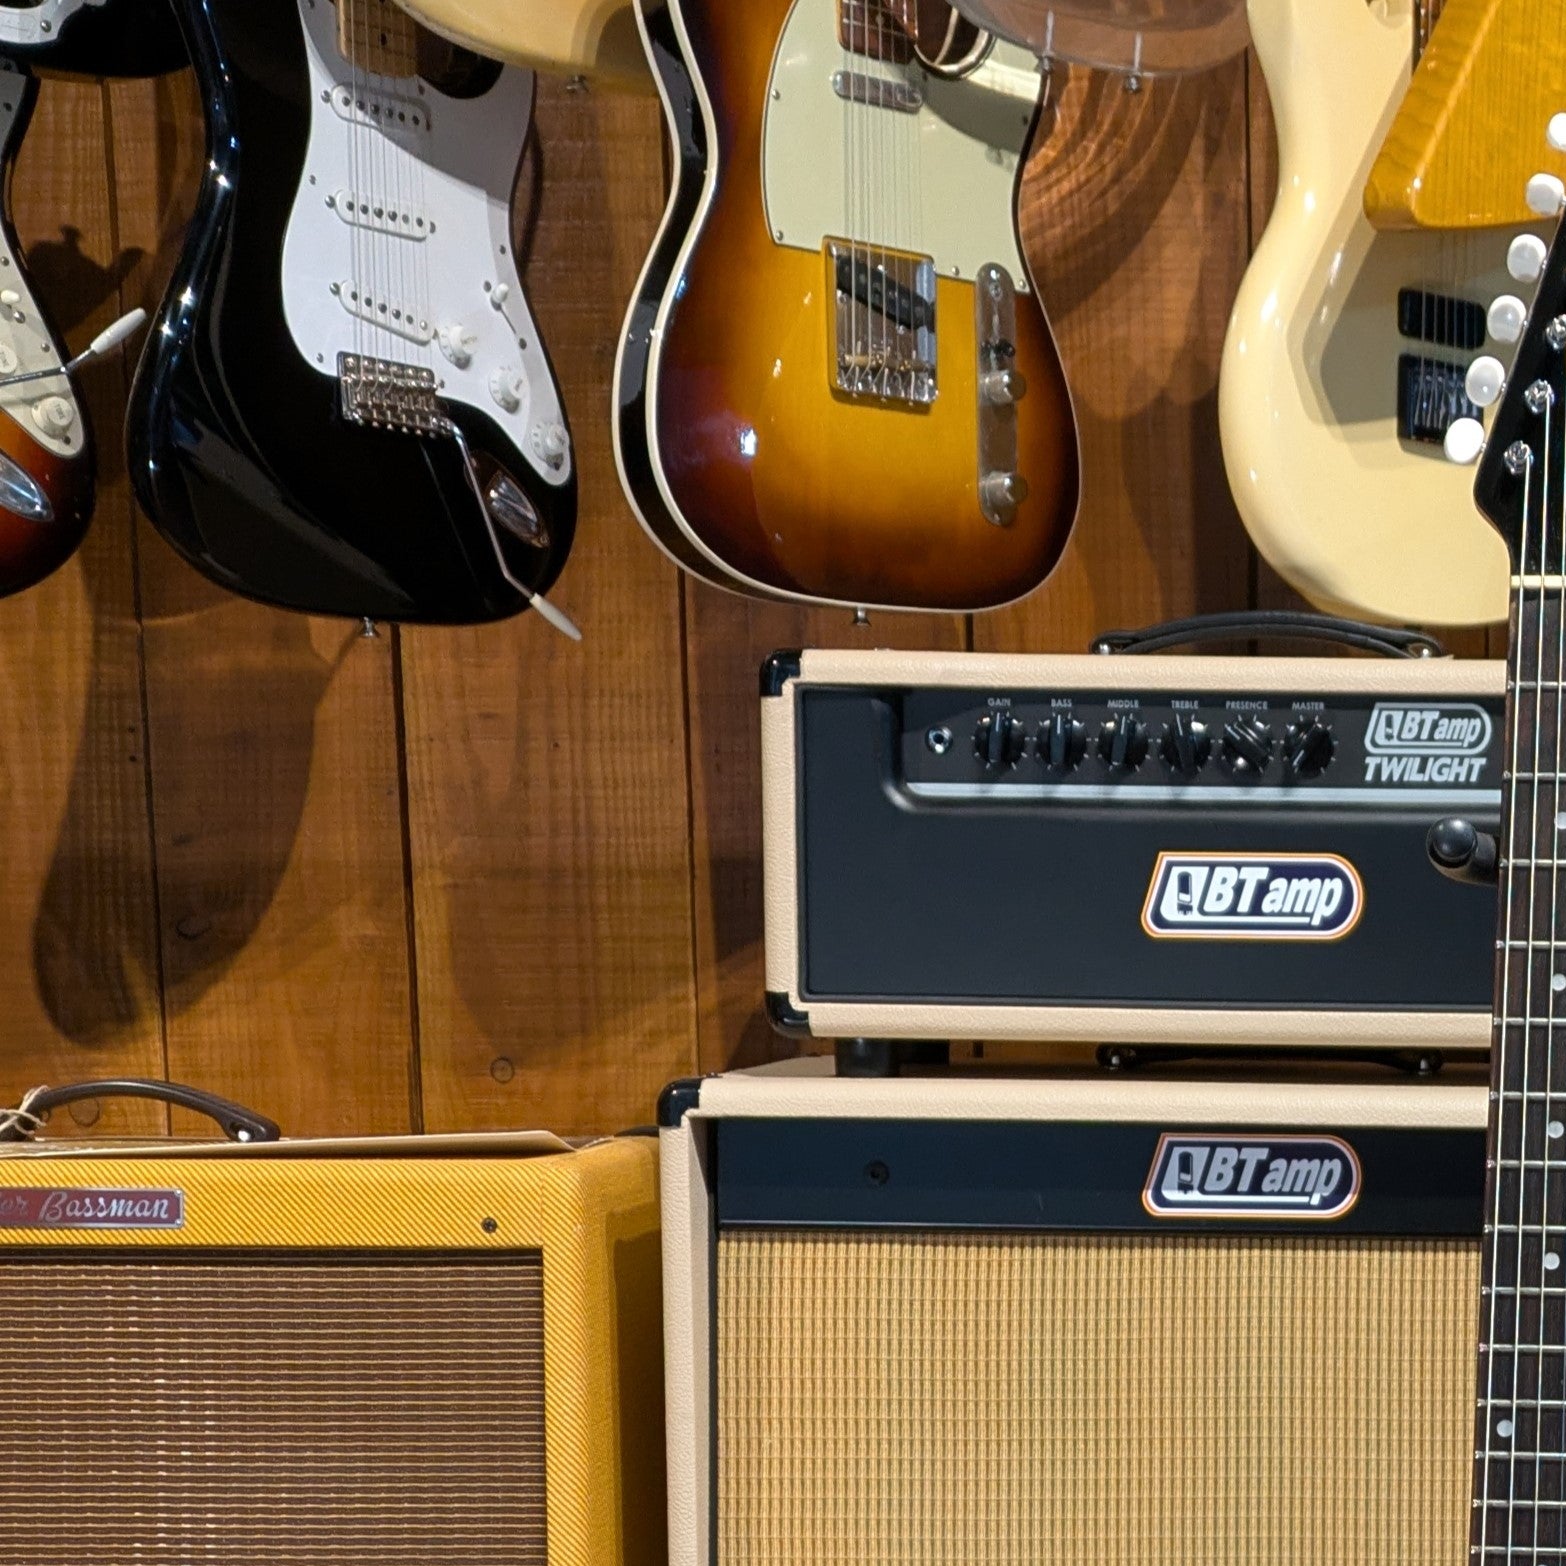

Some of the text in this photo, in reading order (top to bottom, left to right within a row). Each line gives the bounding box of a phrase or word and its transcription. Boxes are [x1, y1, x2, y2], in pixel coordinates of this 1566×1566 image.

[987, 698, 1011, 707] GAIN
[1051, 699, 1073, 707] BASS
[1107, 700, 1139, 708] MIDDLE
[1171, 700, 1199, 709] TREBLE
[1225, 701, 1268, 710] PRESENCE
[1292, 702, 1325, 711] MASTER
[1433, 717, 1482, 747] amp
[1364, 756, 1487, 782] TWILIGHT
[1261, 877, 1343, 926] amp
[1261, 1158, 1342, 1206] amp
[38, 1191, 169, 1223] Bassman
